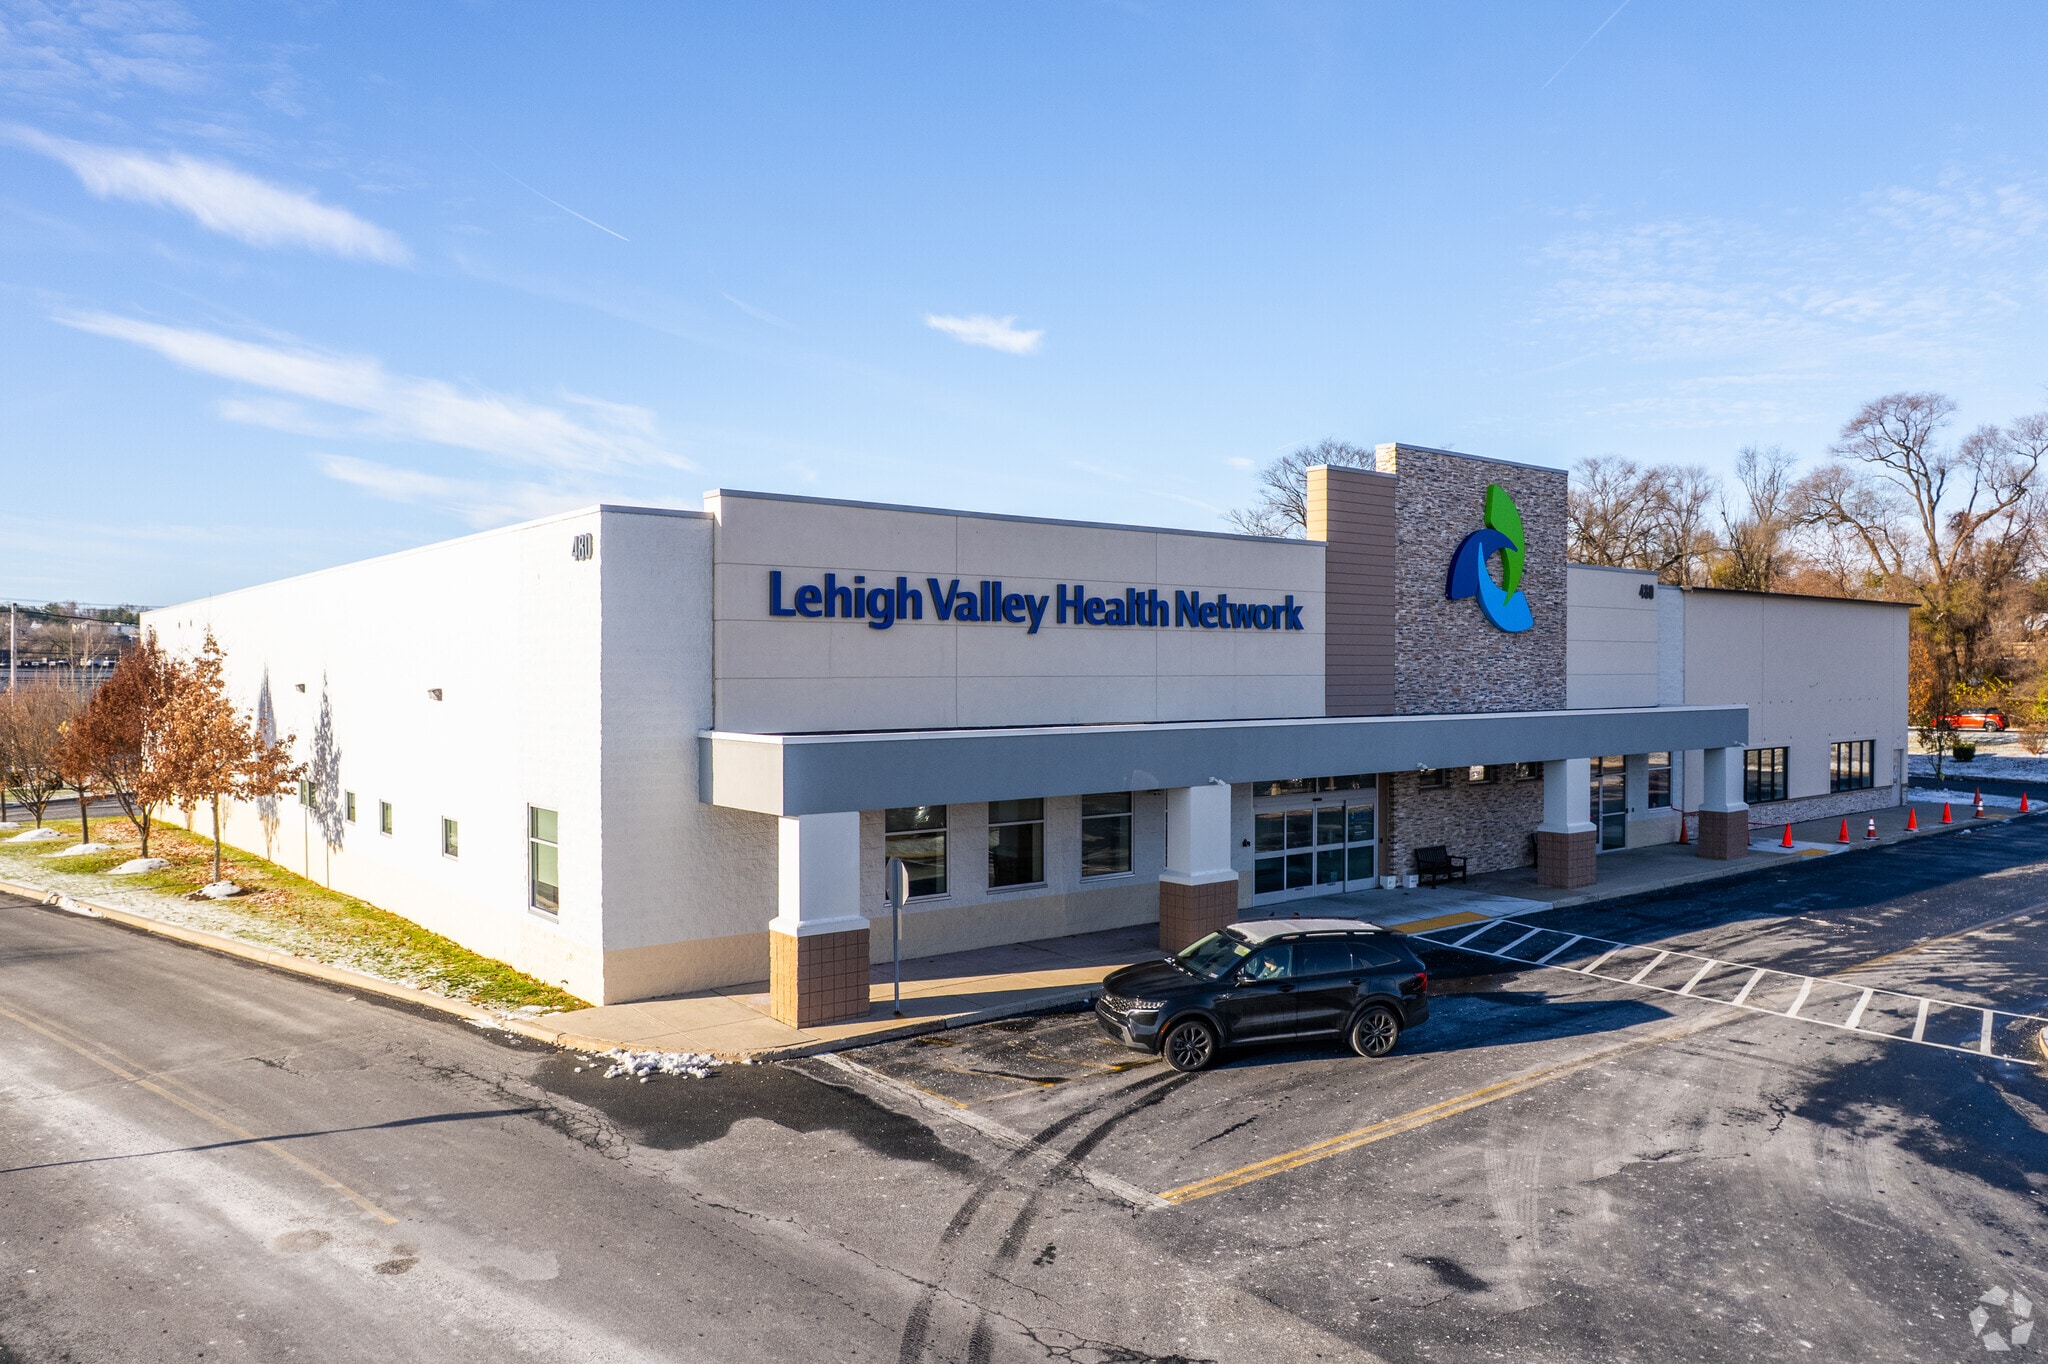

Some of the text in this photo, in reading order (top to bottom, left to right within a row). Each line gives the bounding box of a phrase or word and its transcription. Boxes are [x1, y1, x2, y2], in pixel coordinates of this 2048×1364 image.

[572, 533, 593, 561] 480
[769, 571, 1304, 634] Lehigh Valley Health Network
[1639, 584, 1654, 600] 480
